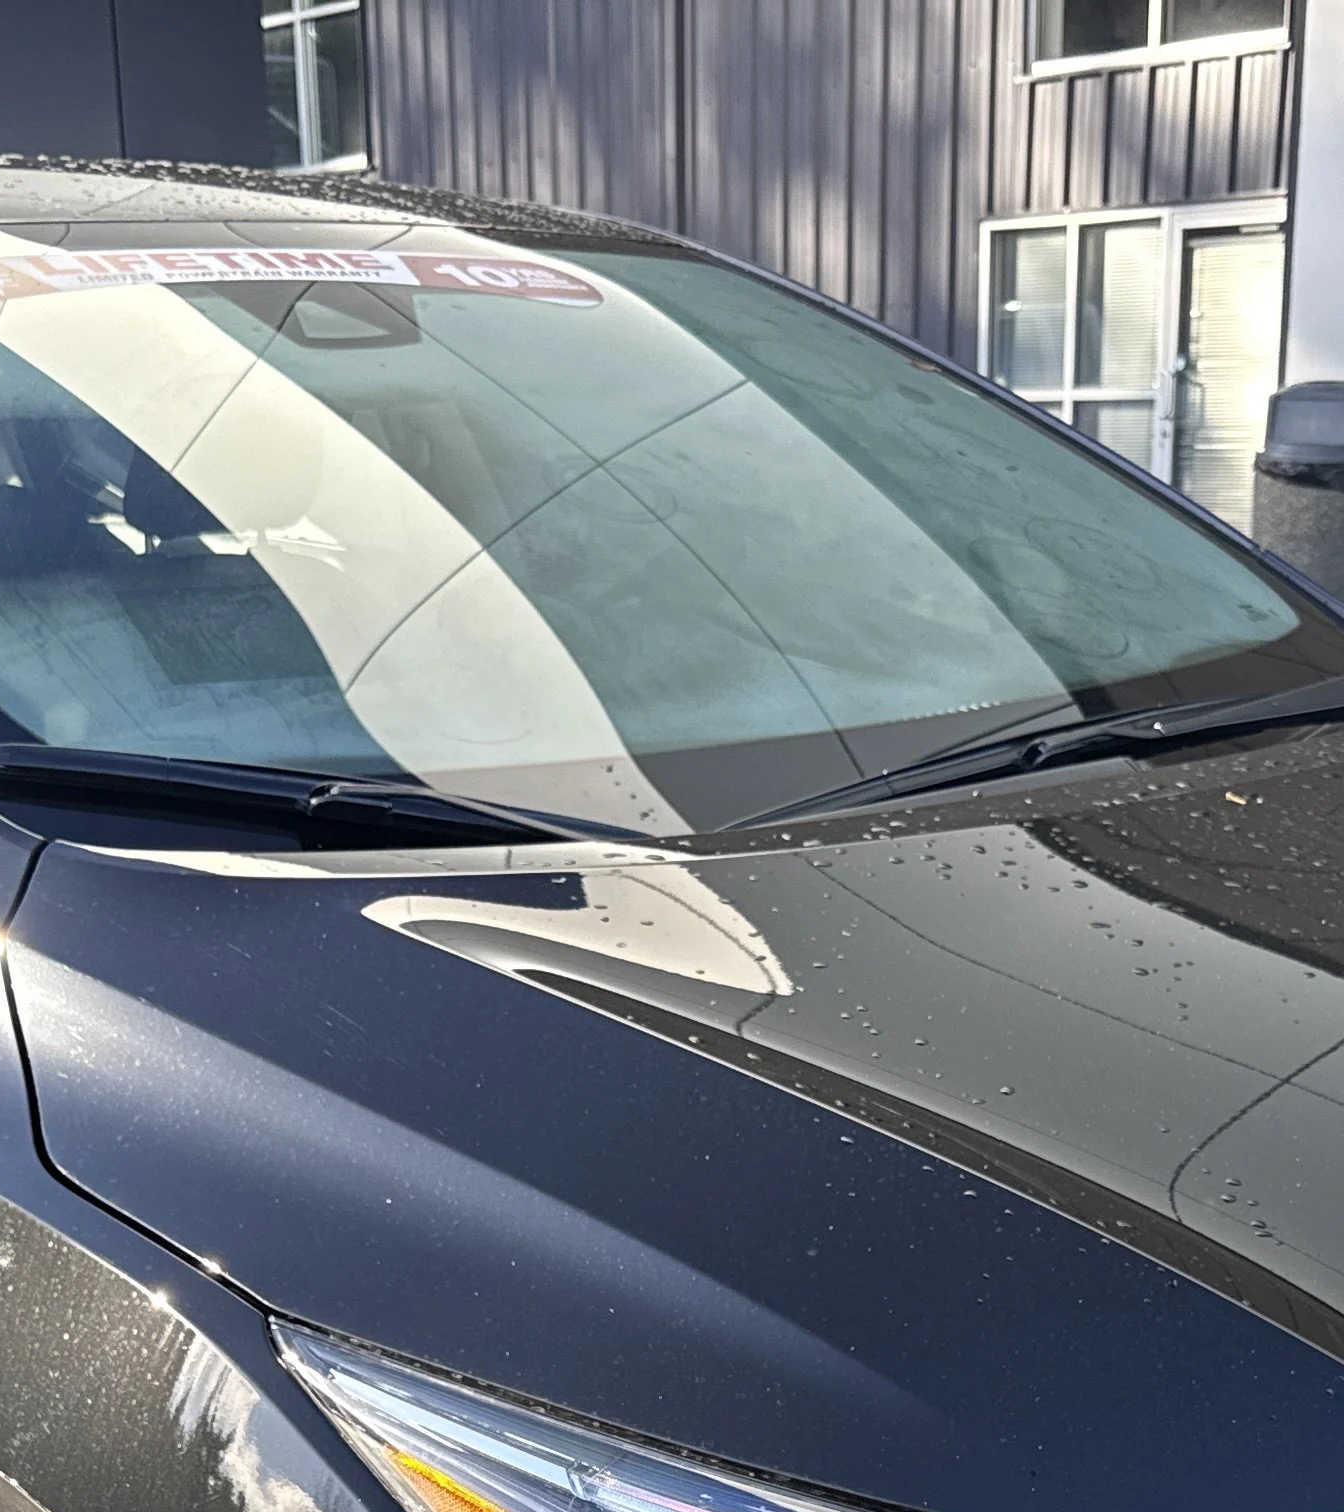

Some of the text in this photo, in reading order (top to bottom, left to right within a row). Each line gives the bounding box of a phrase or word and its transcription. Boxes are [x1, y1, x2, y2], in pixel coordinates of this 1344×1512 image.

[24, 252, 394, 277] LIFETIME
[76, 269, 382, 285] LIMITED POWERTRAIN WARRANTY
[434, 263, 519, 288] 10
